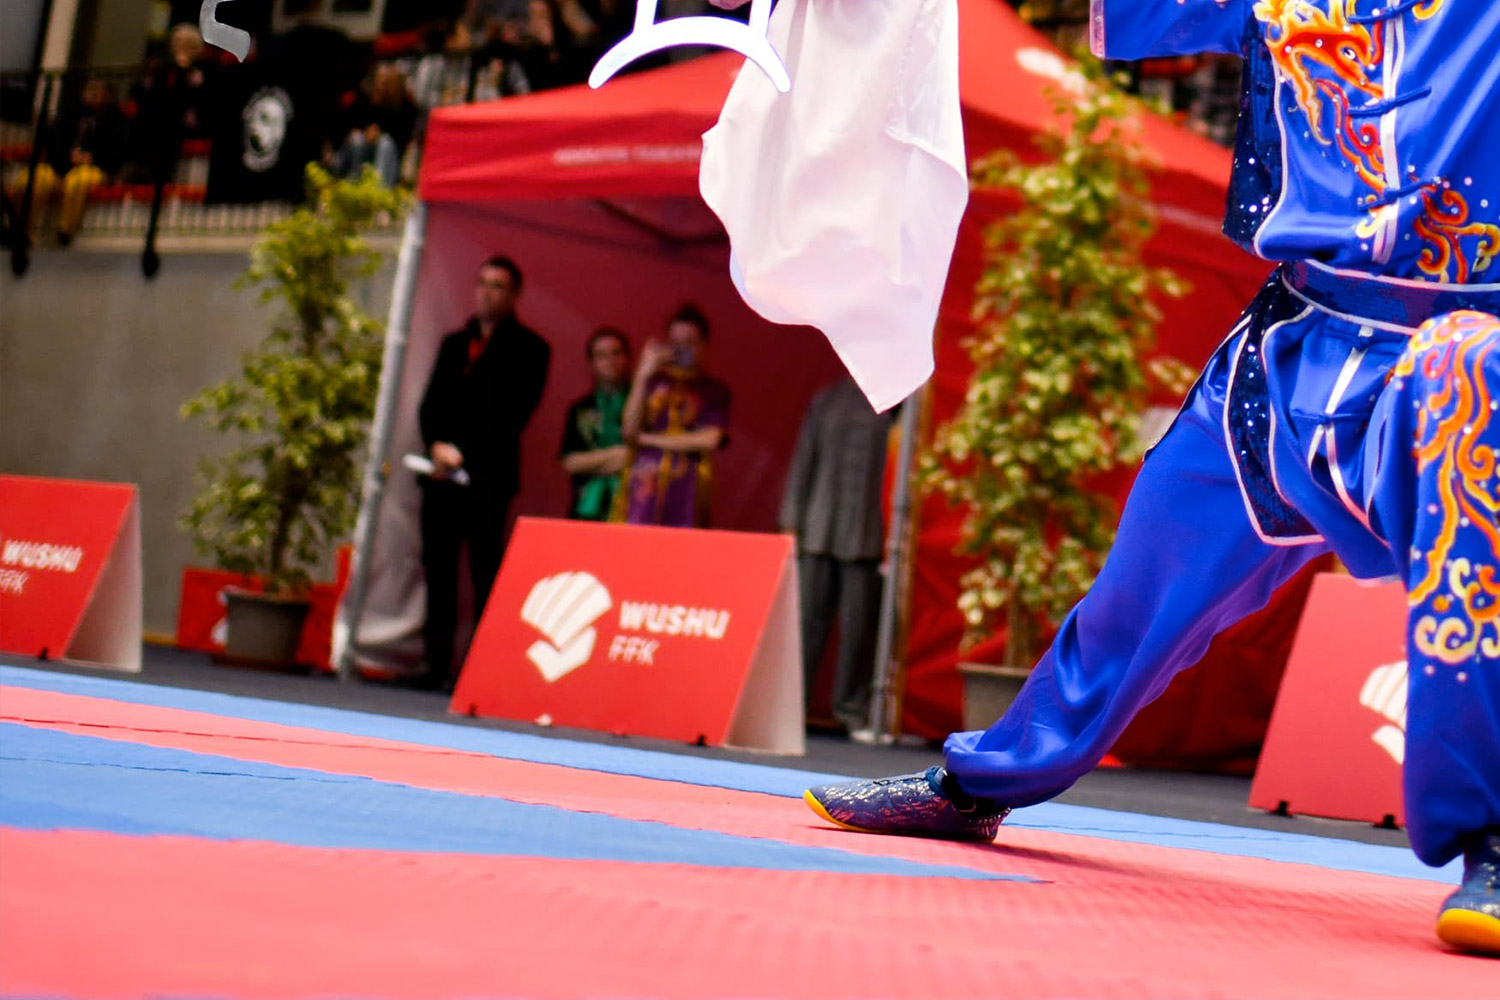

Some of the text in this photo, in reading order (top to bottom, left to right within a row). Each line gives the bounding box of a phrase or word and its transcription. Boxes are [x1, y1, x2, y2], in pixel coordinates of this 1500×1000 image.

[3, 540, 83, 573] WUSHU
[619, 600, 730, 639] WUSHU
[608, 634, 660, 666] FFK
